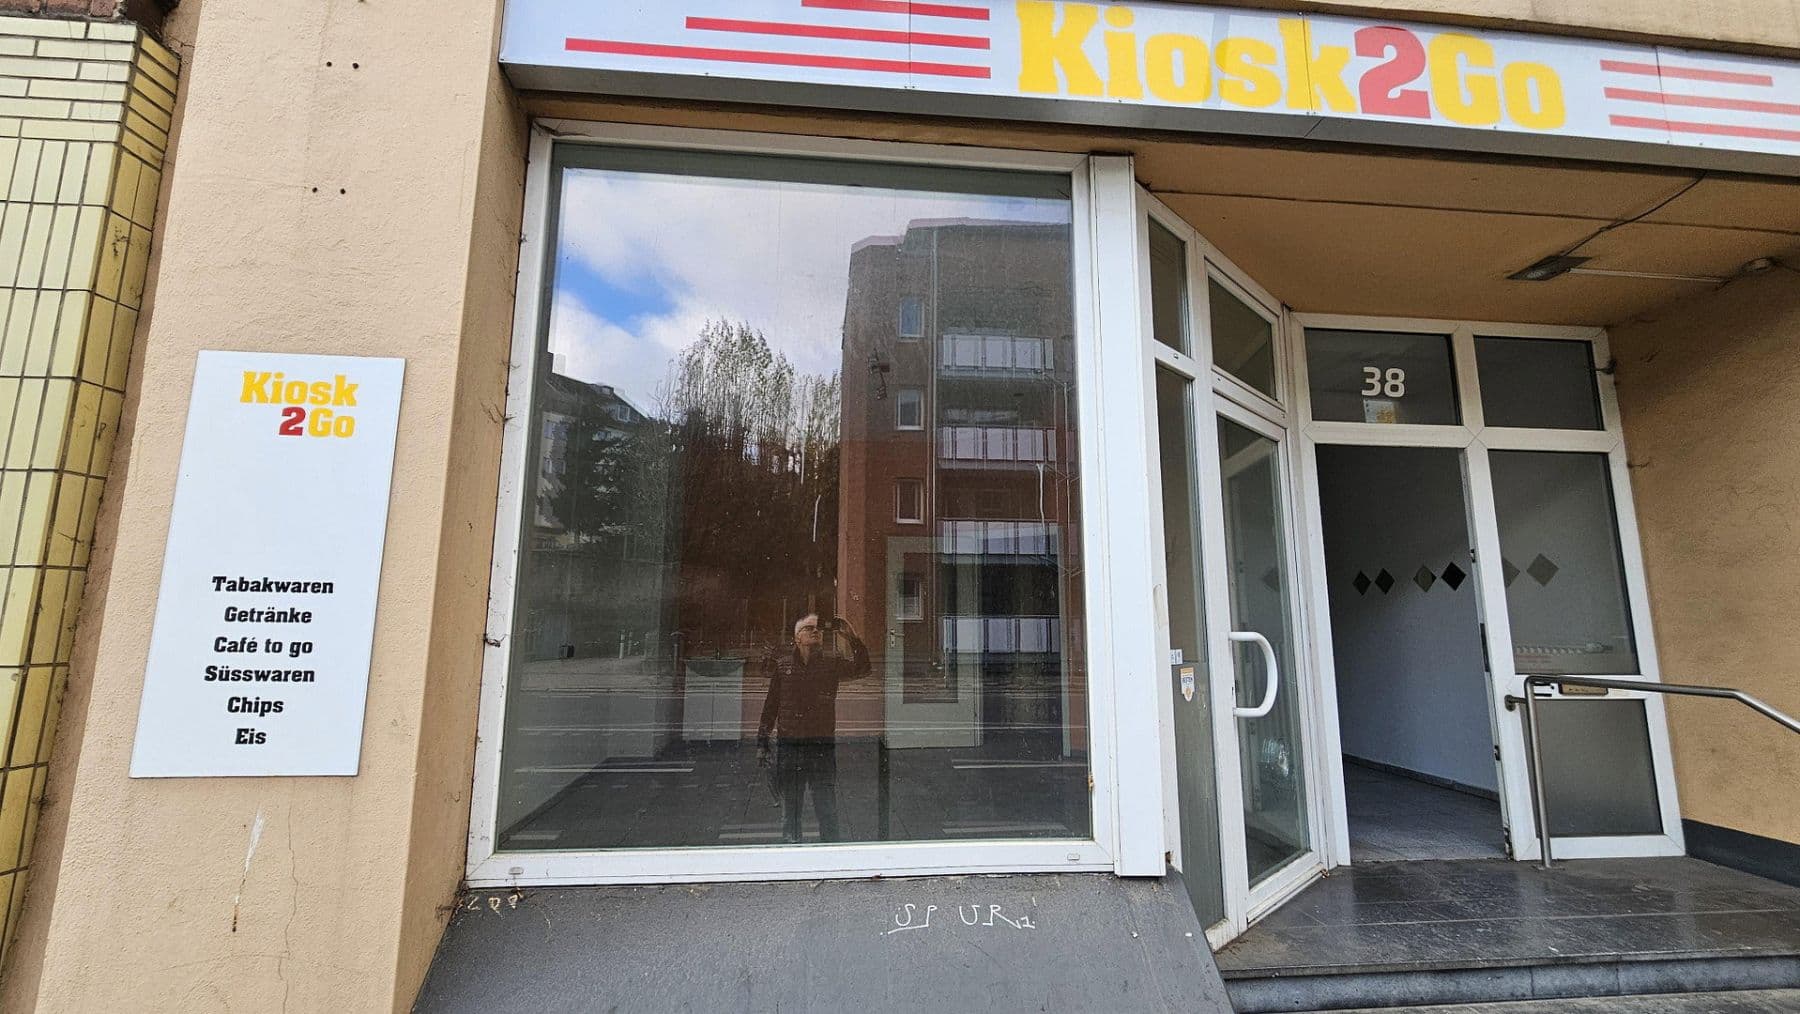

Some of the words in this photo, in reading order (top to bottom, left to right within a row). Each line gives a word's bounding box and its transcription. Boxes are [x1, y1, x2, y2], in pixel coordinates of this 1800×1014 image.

[1016, 1, 1566, 130] Kiosk2Go
[240, 370, 359, 407] Kiosk
[1361, 366, 1406, 398] 38
[279, 406, 356, 438] 2Go
[211, 576, 334, 594] Tabakwaren
[224, 606, 312, 624] Getränke
[213, 637, 258, 654] Café
[264, 638, 283, 654] to
[288, 641, 313, 657] go
[204, 665, 315, 683] Süsswaren
[227, 697, 284, 717] Chips
[234, 728, 267, 745] Eis
